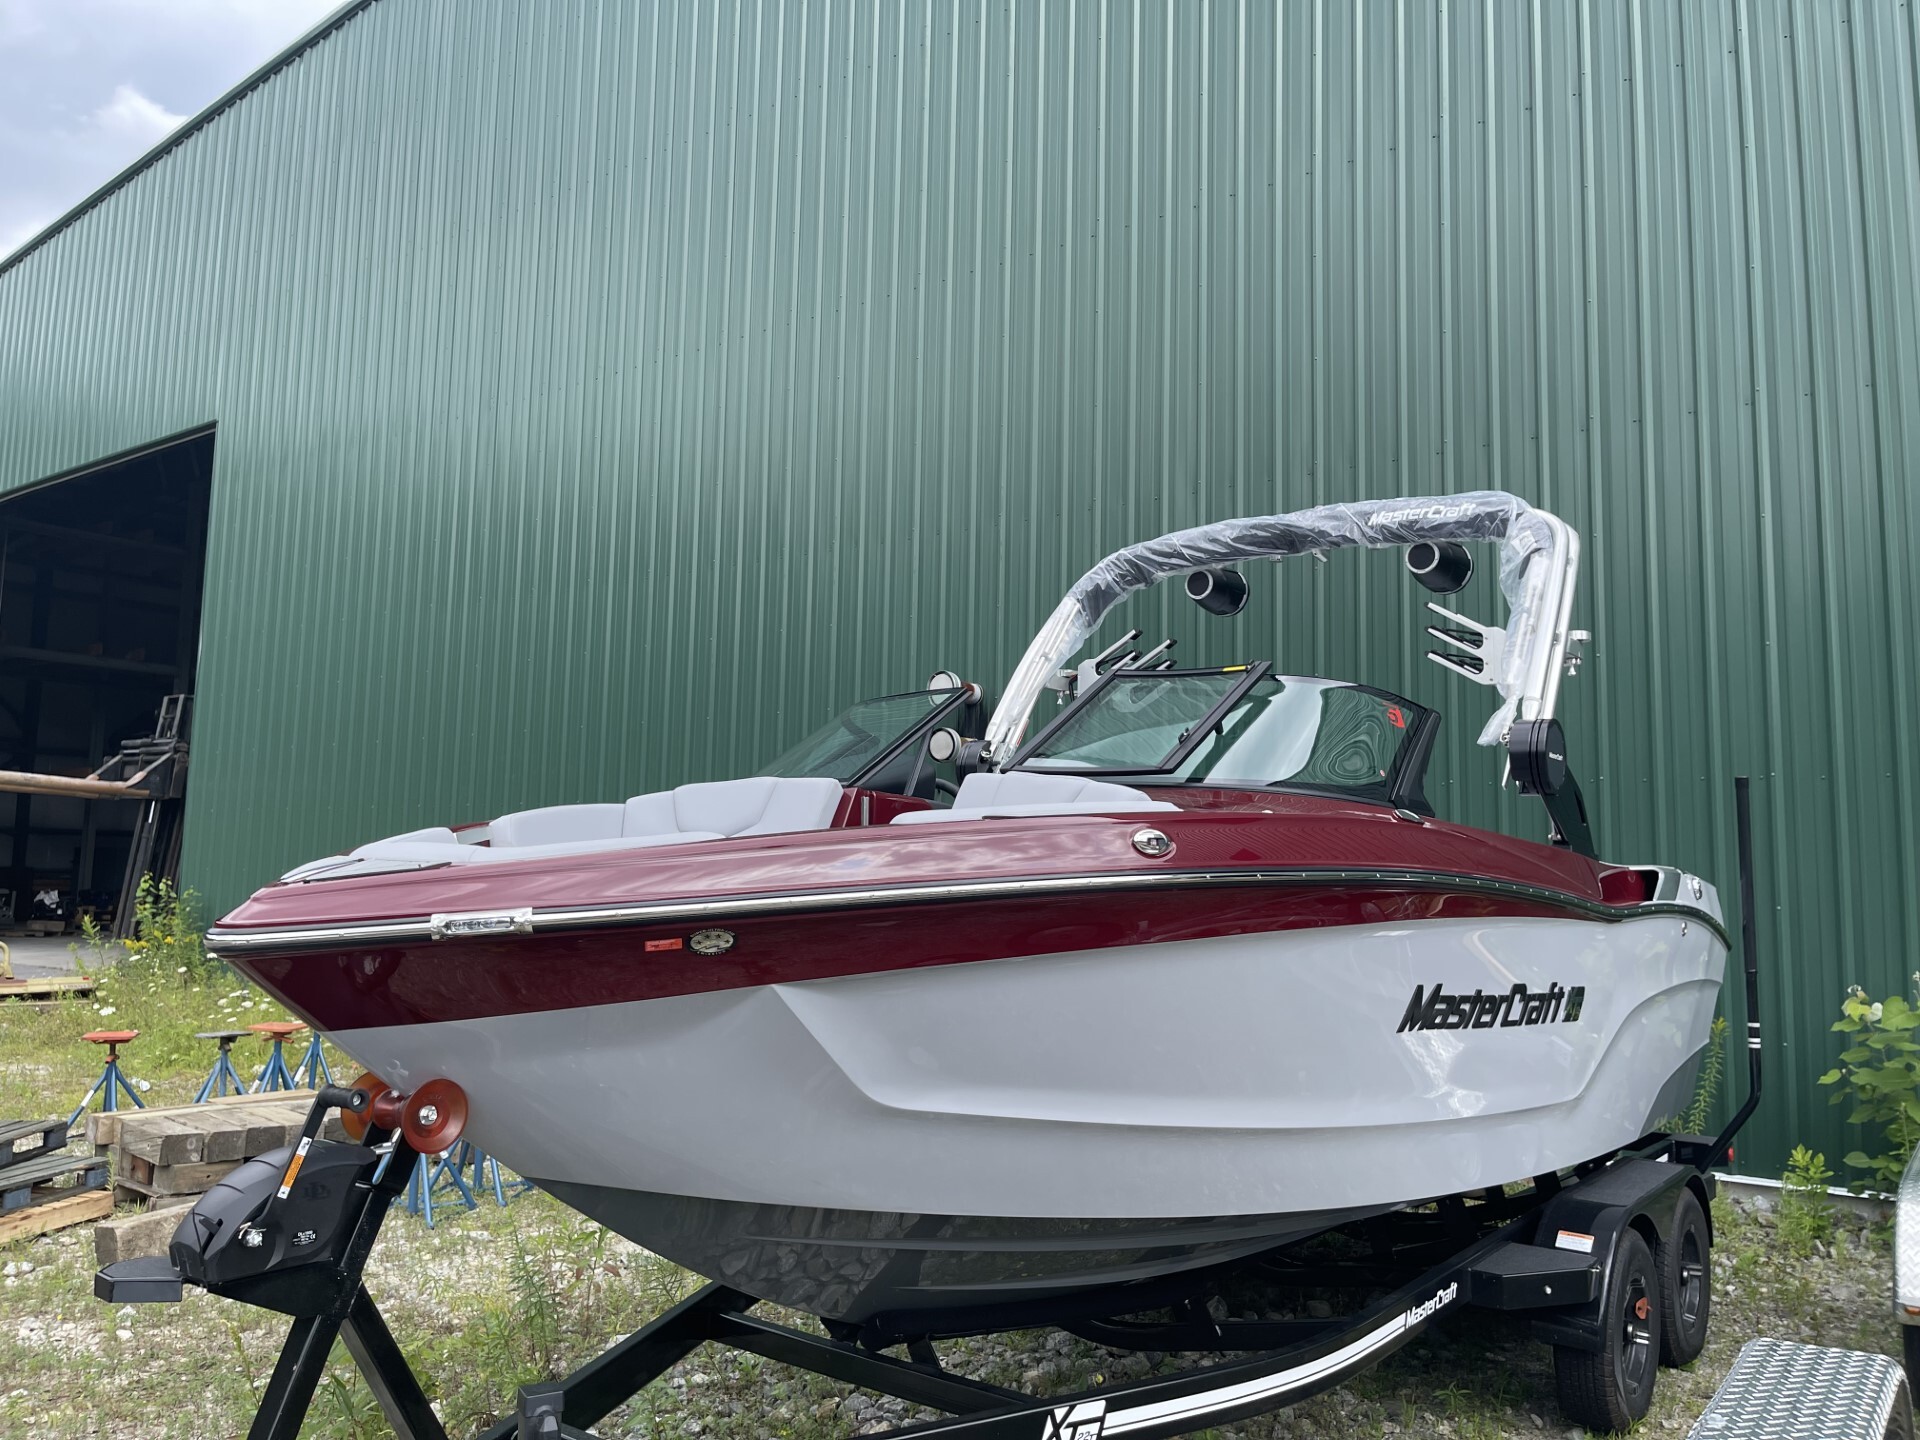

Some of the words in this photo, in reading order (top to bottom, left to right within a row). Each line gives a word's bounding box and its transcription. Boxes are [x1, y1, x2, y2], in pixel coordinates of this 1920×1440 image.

[1367, 501, 1477, 526] MasterCraft
[1395, 981, 1566, 1034] MasterCraft
[1405, 1281, 1458, 1329] MasterCraft
